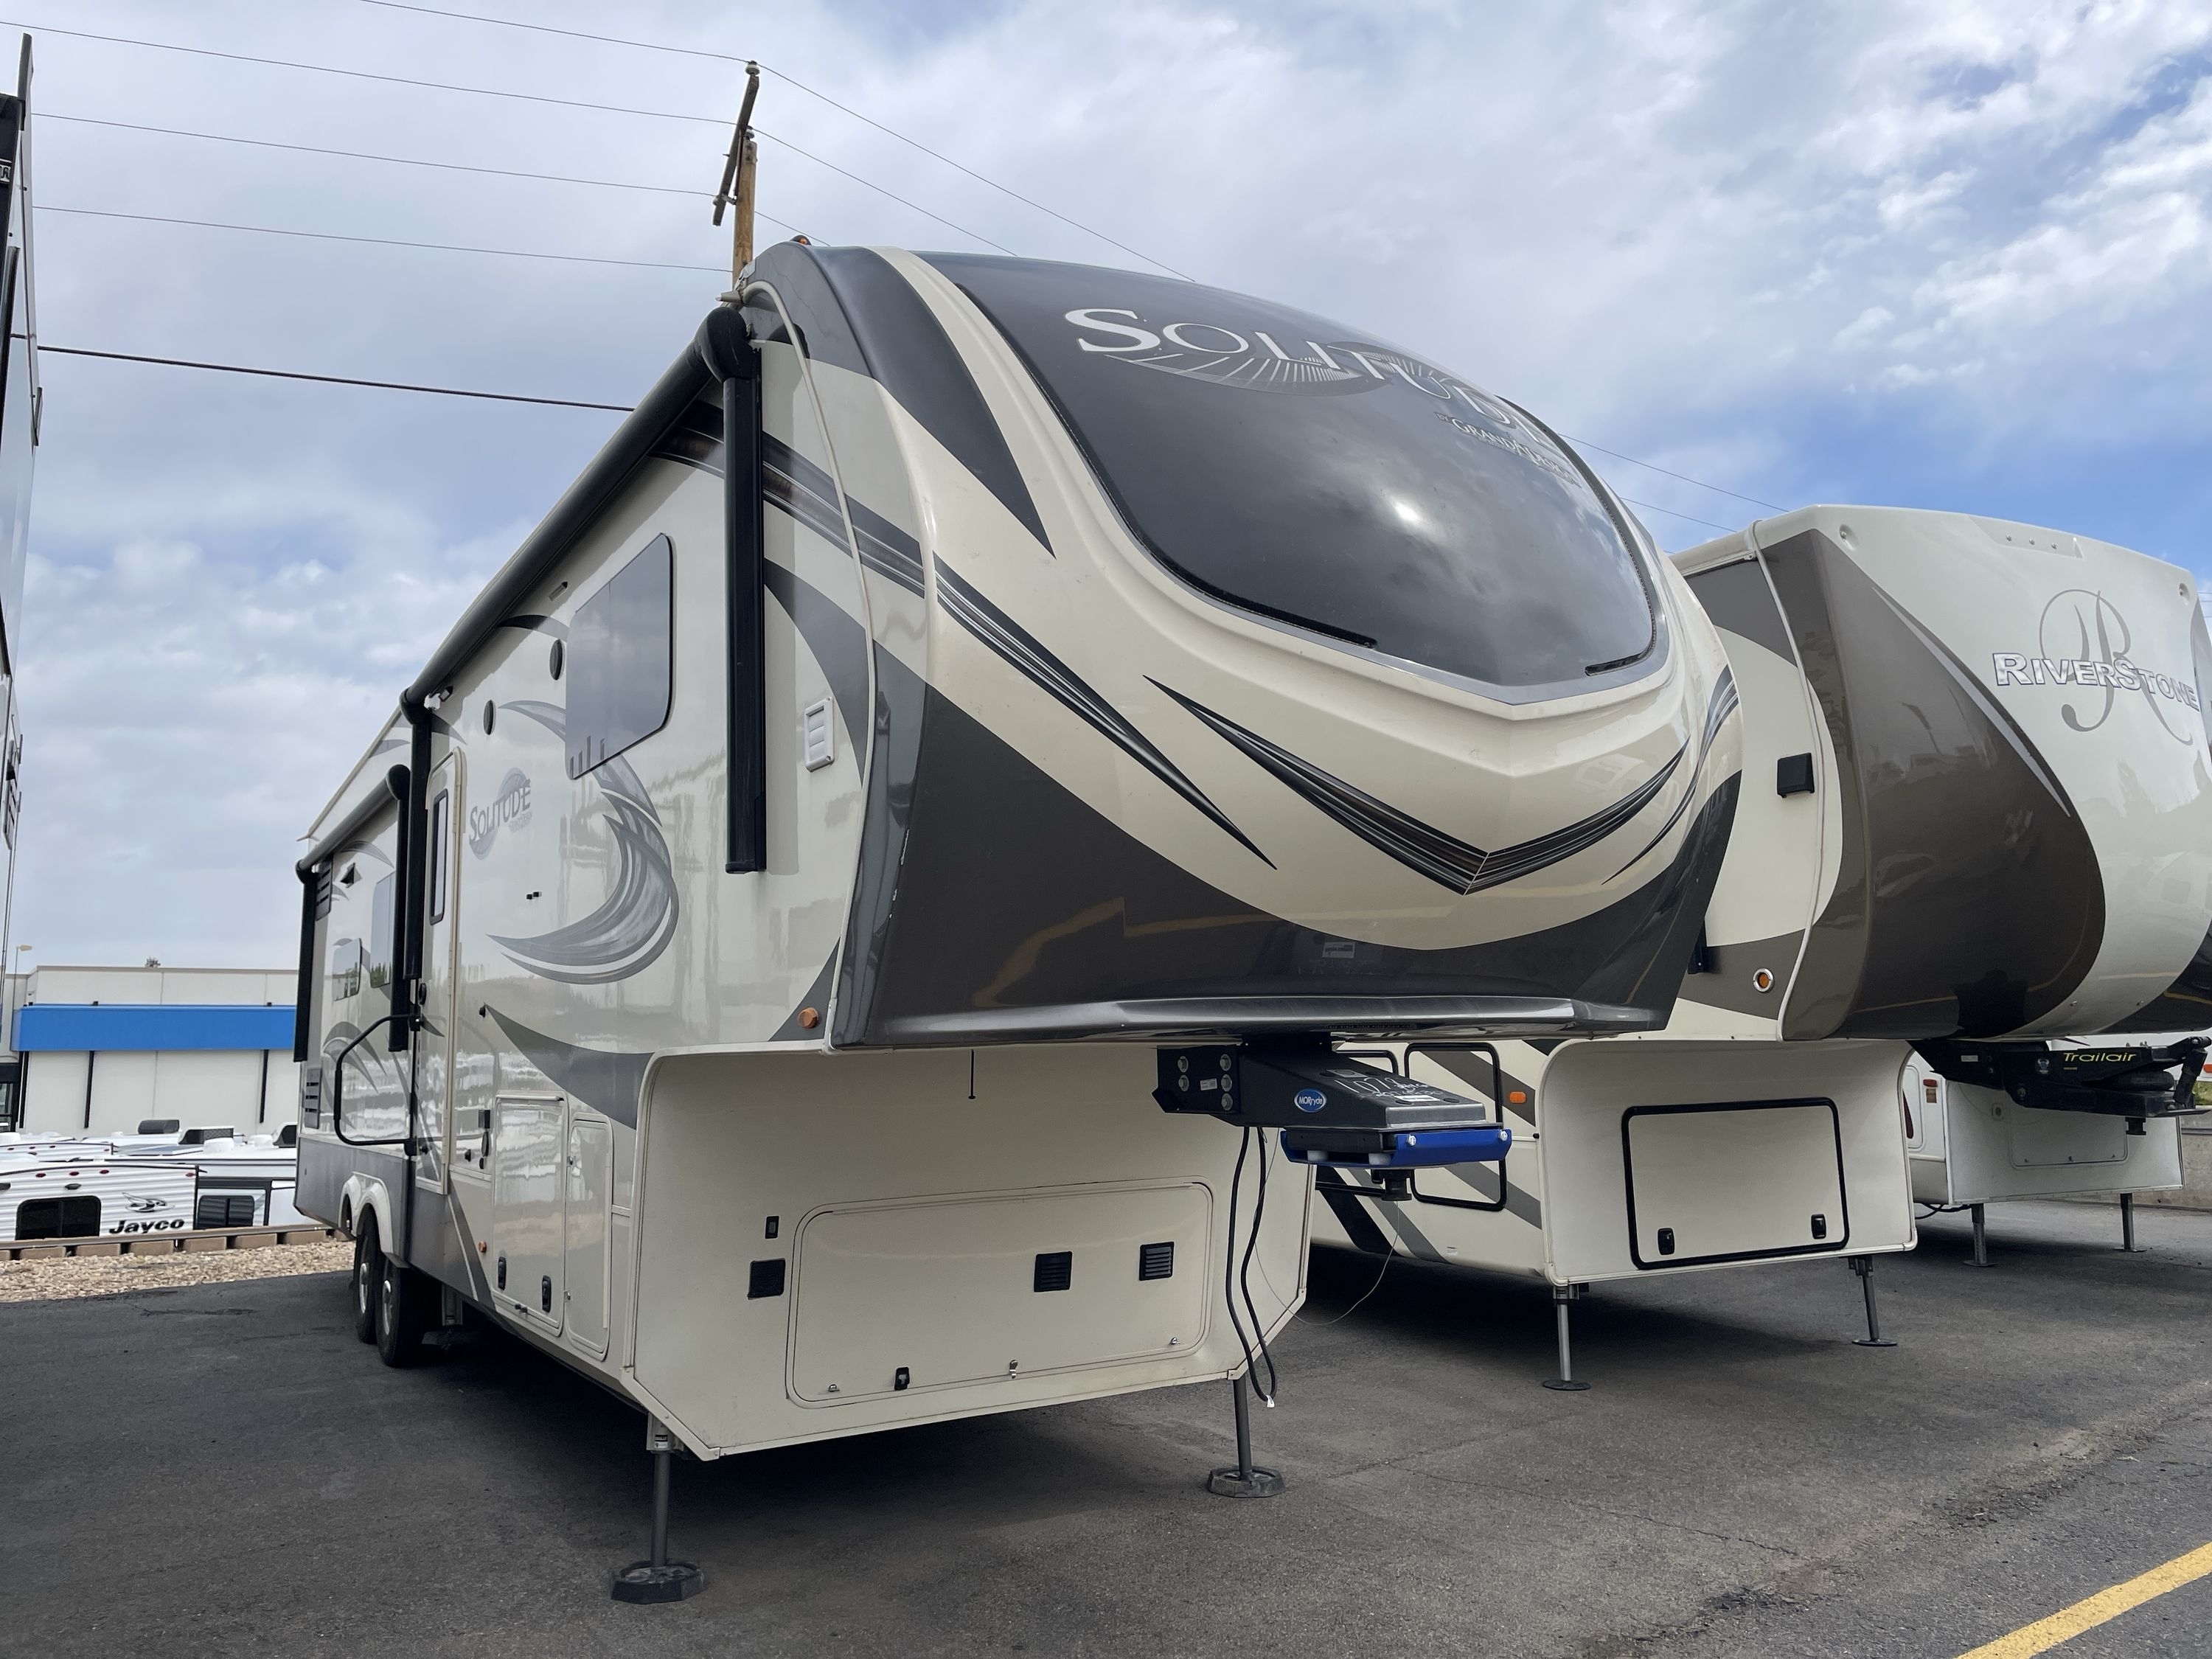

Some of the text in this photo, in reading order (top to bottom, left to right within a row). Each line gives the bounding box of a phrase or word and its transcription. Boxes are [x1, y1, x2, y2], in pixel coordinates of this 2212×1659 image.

[1992, 653, 2200, 712] RIVERSTONE
[470, 778, 531, 842] SOLITUDE
[2063, 1052, 2137, 1062] Trailair
[109, 1219, 185, 1234] Jayco
